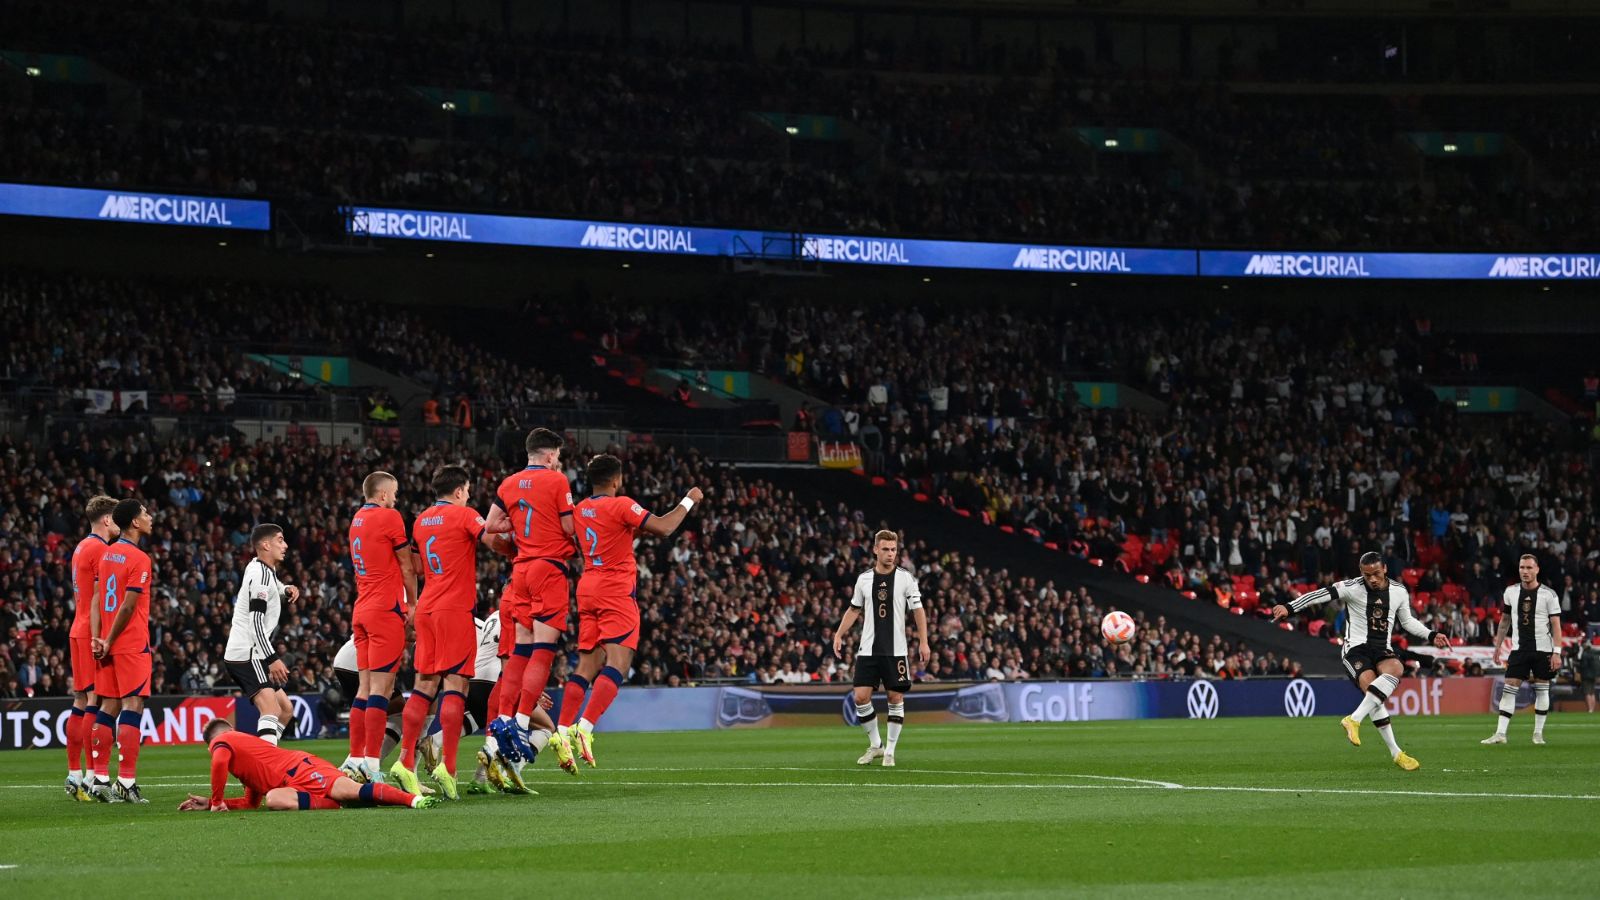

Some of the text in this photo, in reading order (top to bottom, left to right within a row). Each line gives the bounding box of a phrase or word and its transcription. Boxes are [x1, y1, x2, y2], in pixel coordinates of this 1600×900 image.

[99, 195, 231, 225] MERCURIAL
[581, 225, 697, 252] MERCURIAL
[1013, 248, 1131, 271] MERCURIAL
[1244, 255, 1370, 276] MERCURIAL
[1489, 256, 1600, 277] MERCURI
[518, 498, 533, 537] 7
[352, 536, 367, 576] 5
[425, 535, 443, 574] 6
[585, 527, 603, 565] 2
[104, 573, 117, 612] 8
[878, 603, 887, 618] 6
[481, 618, 500, 646] 2
[897, 660, 906, 675] 6
[1019, 683, 1093, 722] Golf
